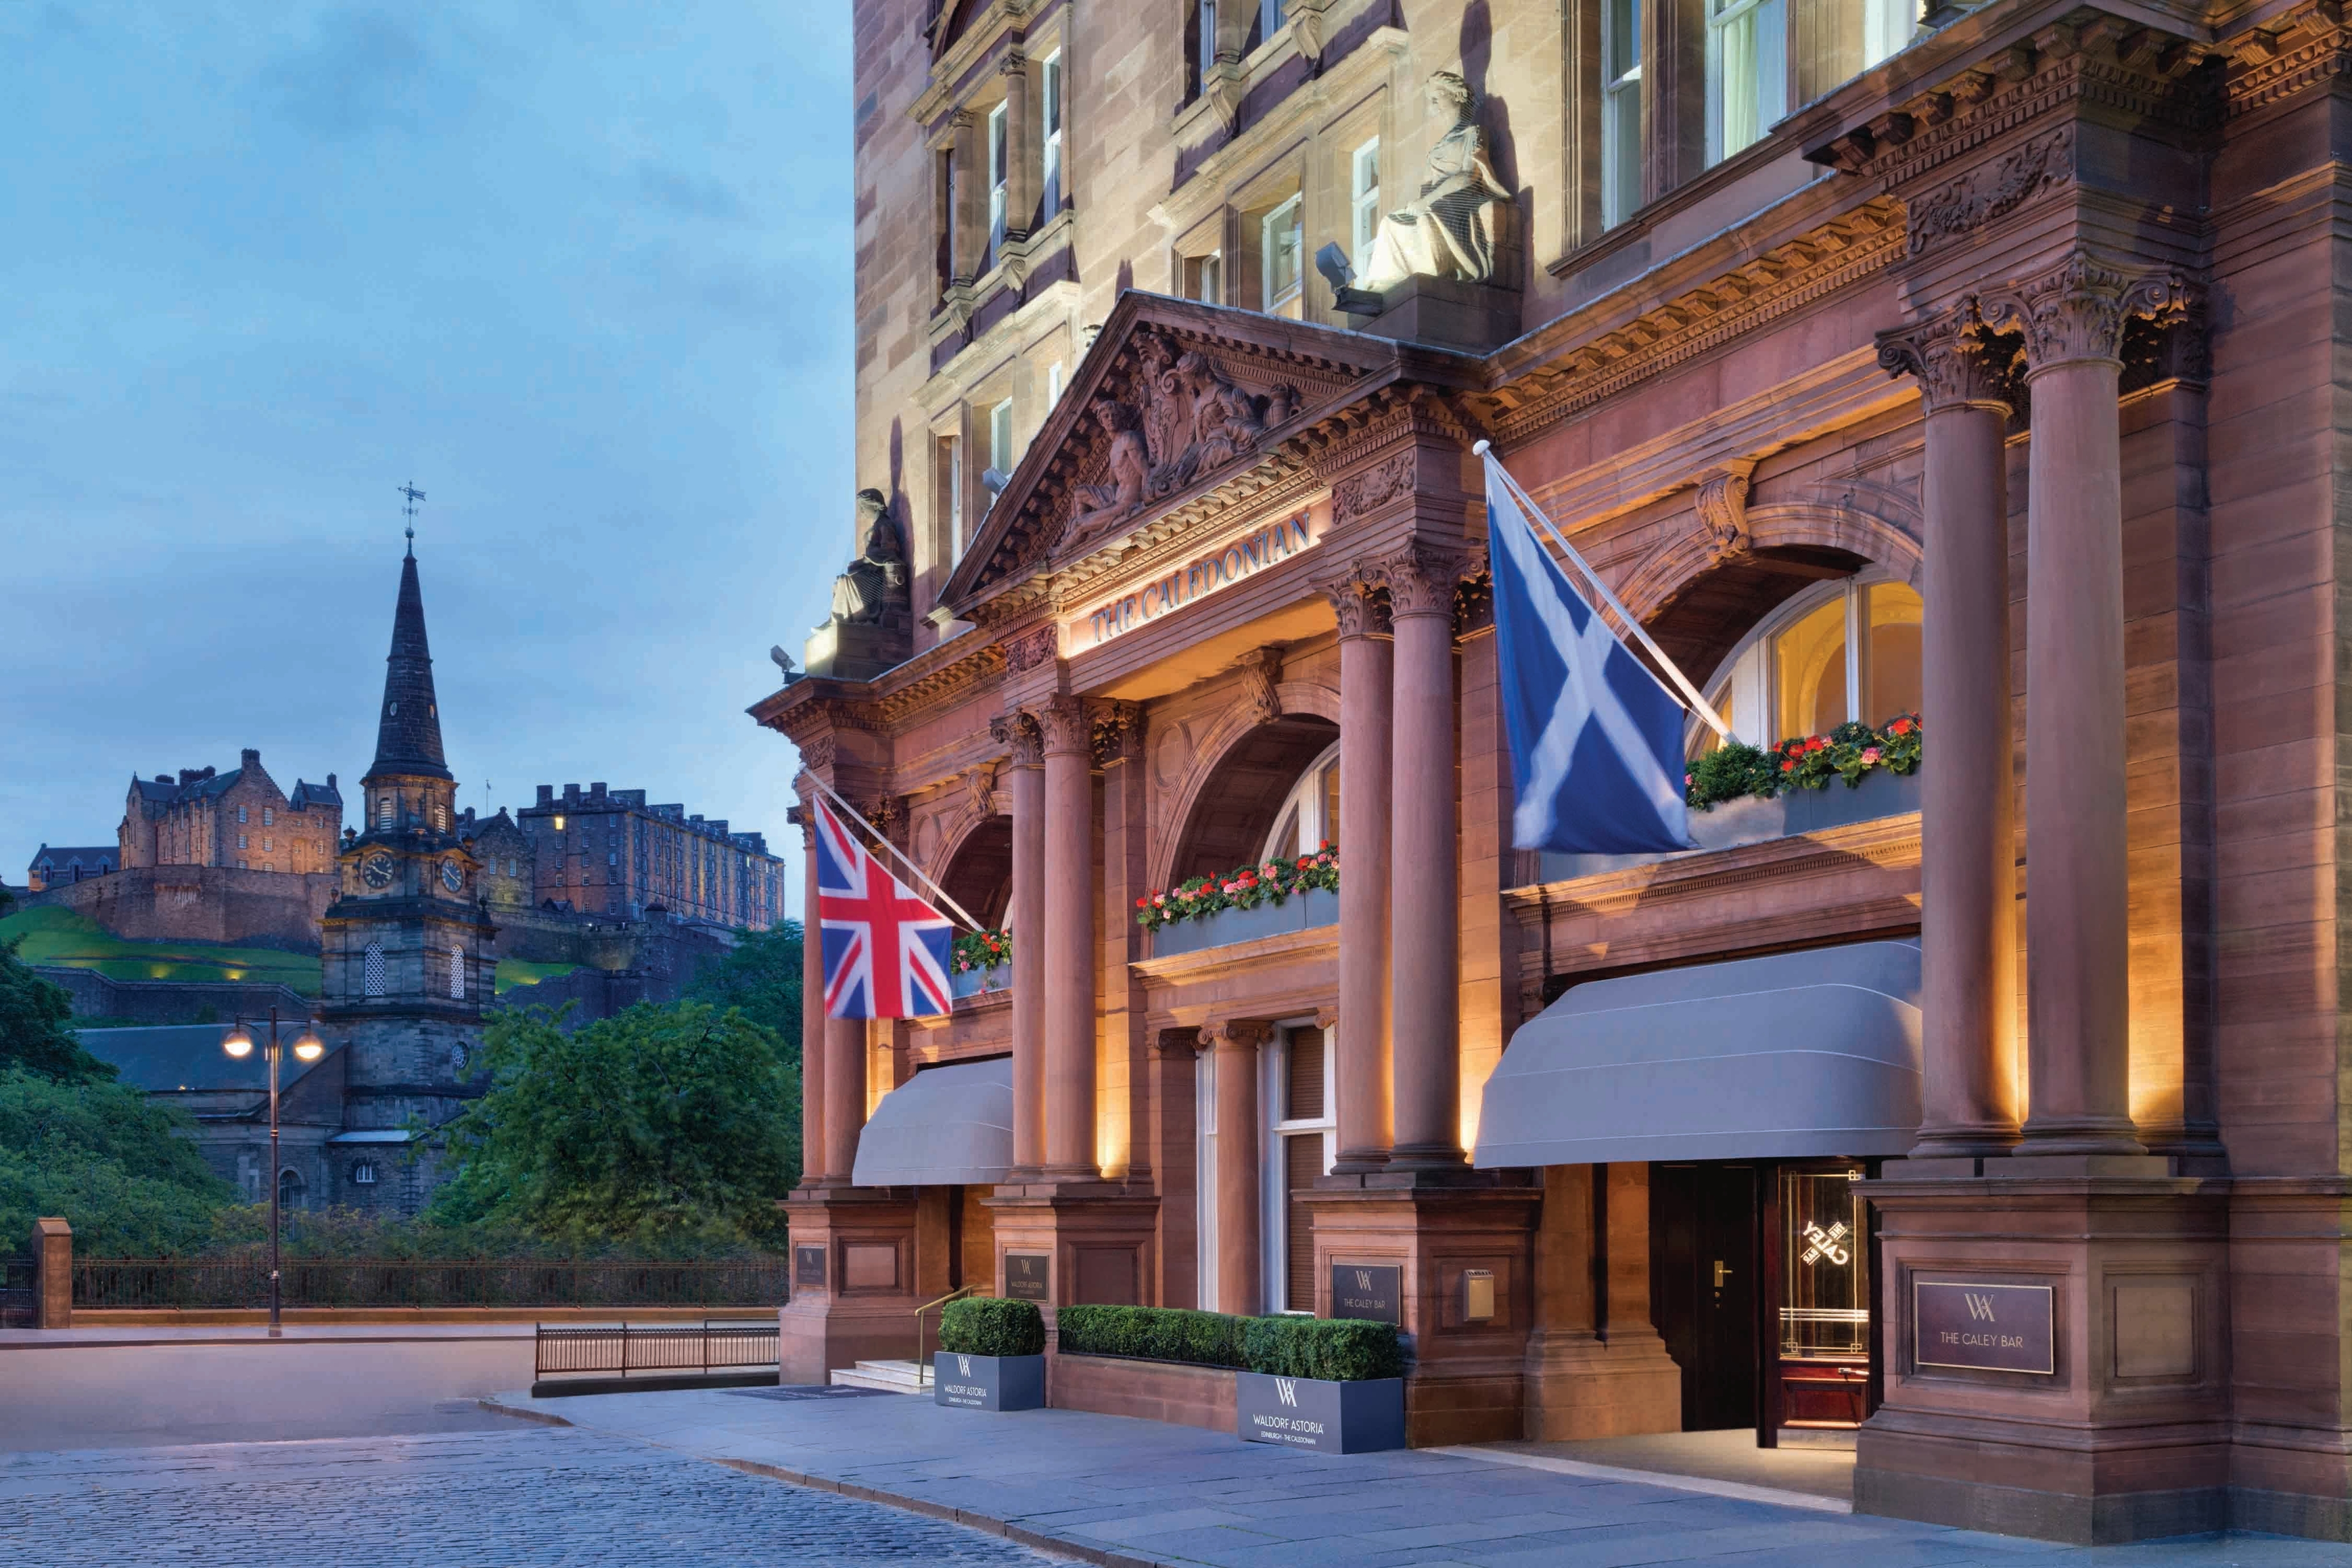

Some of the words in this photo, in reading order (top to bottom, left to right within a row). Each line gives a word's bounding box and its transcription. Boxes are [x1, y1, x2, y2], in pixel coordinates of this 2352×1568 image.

[1090, 597, 1136, 644] THE
[1141, 511, 1311, 622] CALEDONIAN
[1344, 1298, 1354, 1308] THE
[1354, 1299, 1373, 1308] CALEY
[1374, 1300, 1385, 1309] BAR
[1940, 1332, 1959, 1344] THE
[1962, 1333, 1997, 1347] CALEY
[2001, 1335, 2023, 1348] BAR
[944, 1384, 967, 1395] WALDORF
[967, 1387, 987, 1397] ASTORIA
[1253, 1413, 1289, 1430] WALDORF
[1291, 1420, 1324, 1434] ASTORIA
[1261, 1430, 1282, 1440] EDINBURGH
[1291, 1435, 1316, 1445] CALEDONIAN
